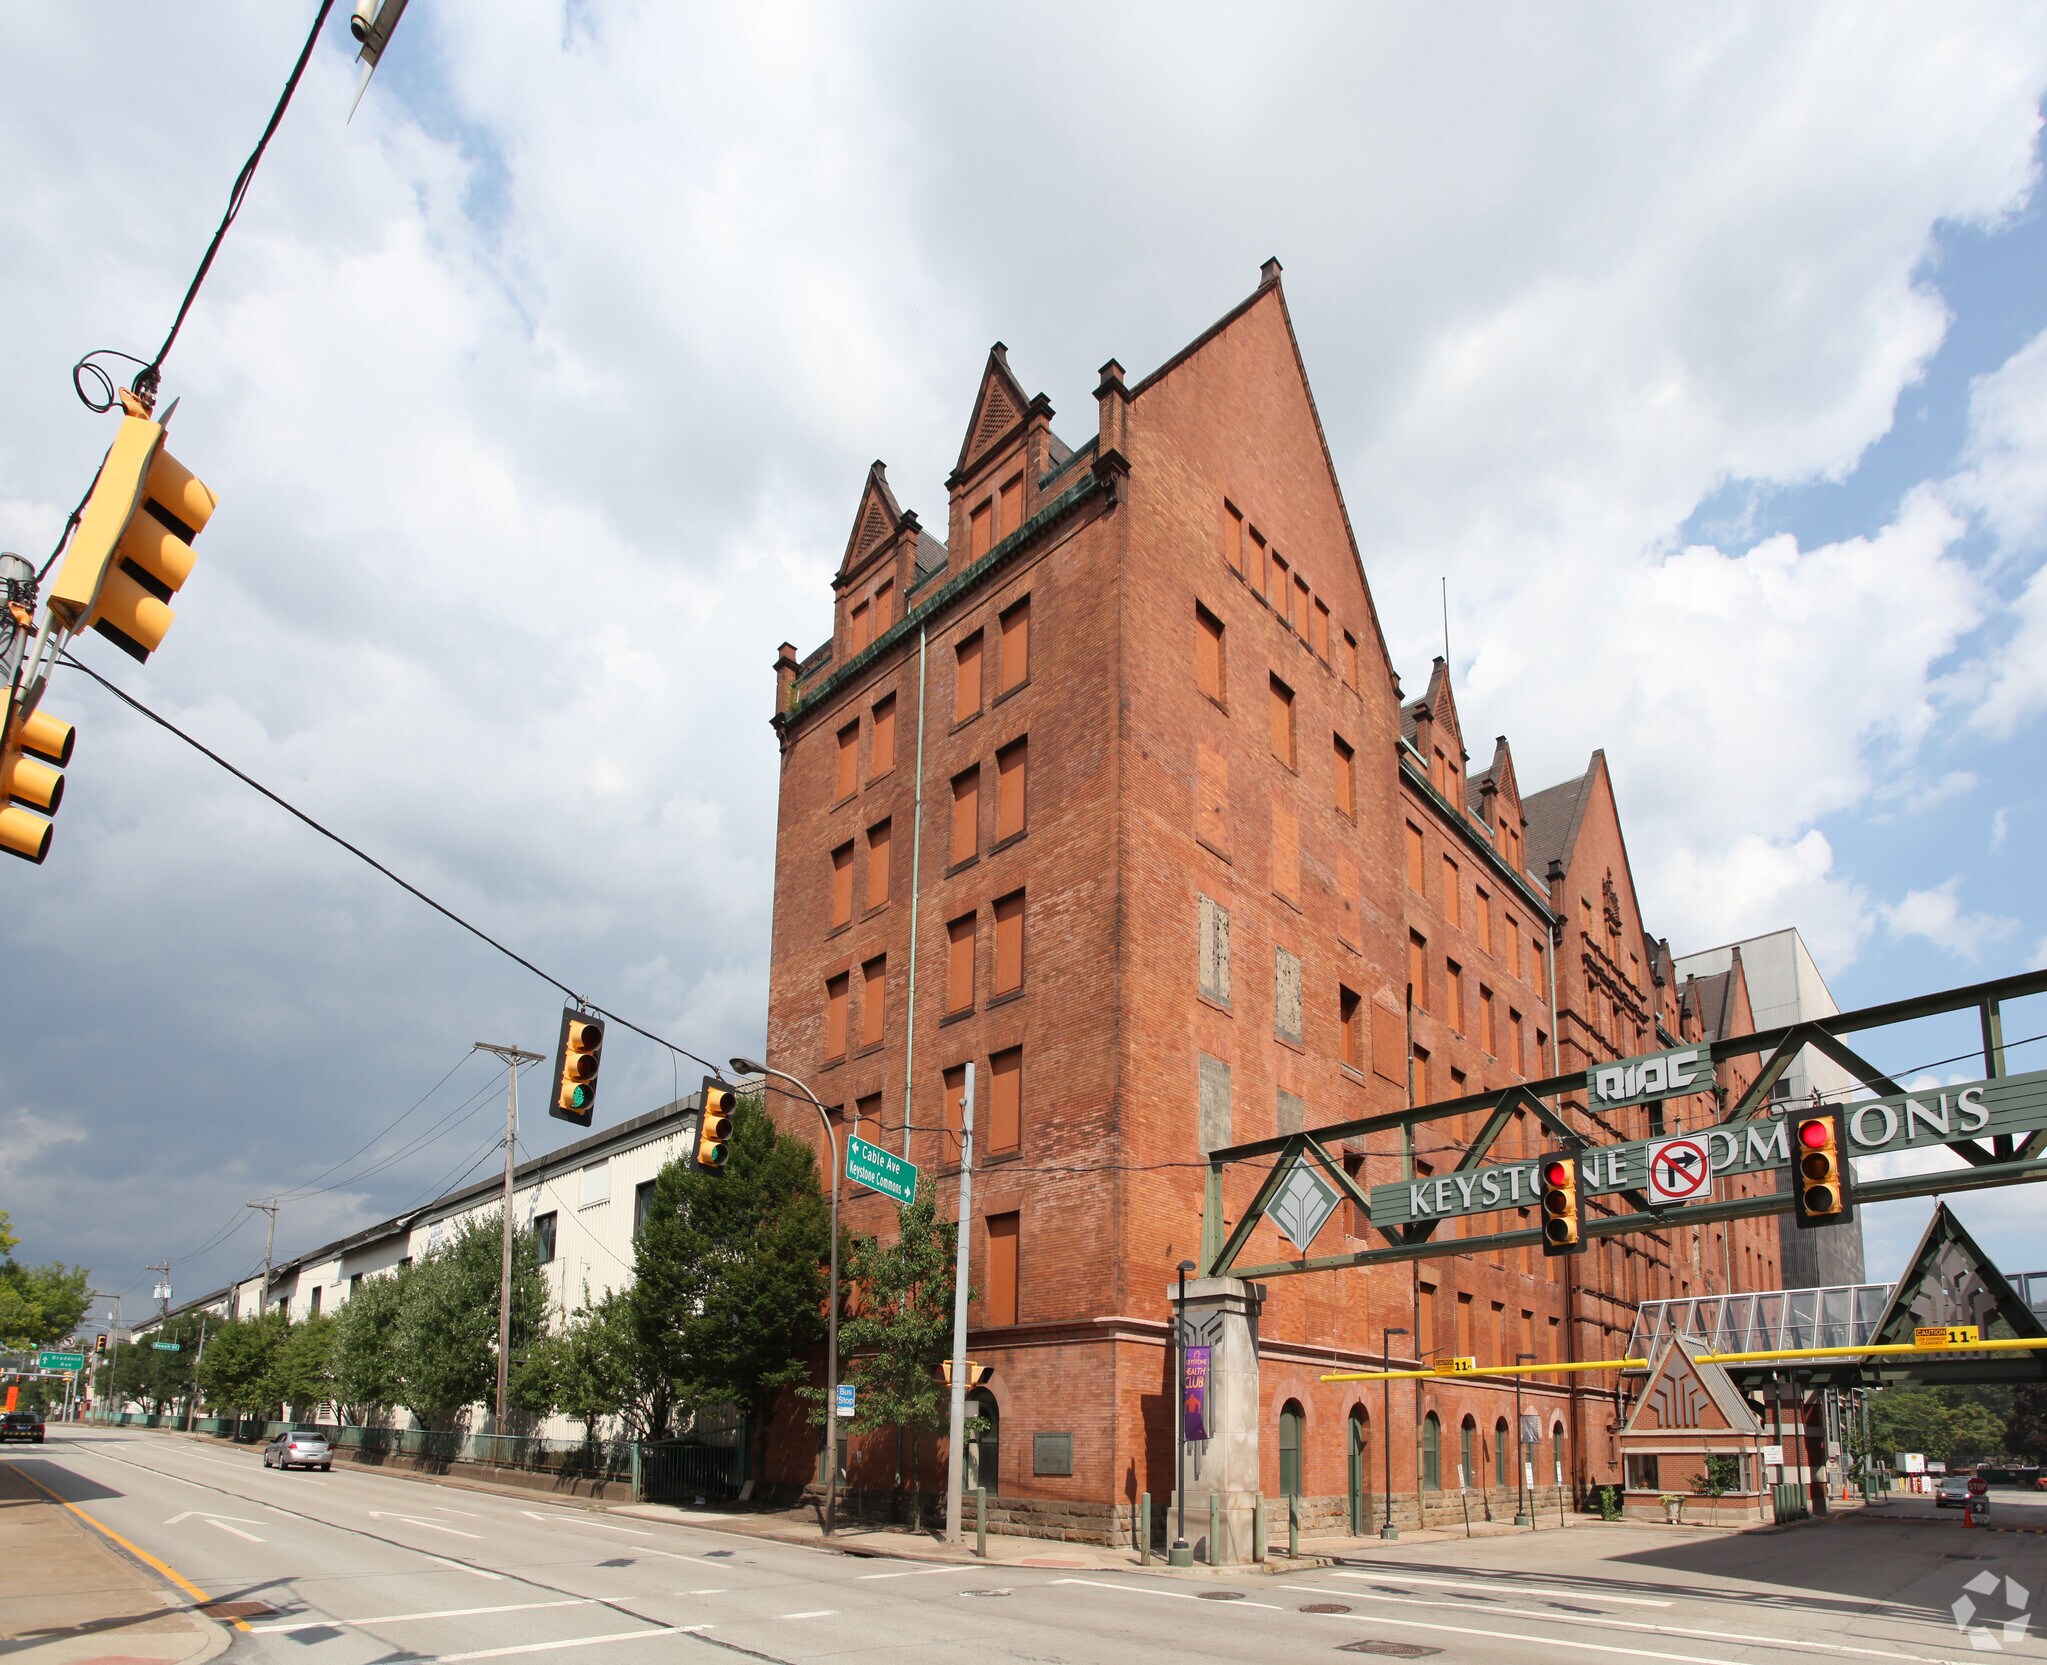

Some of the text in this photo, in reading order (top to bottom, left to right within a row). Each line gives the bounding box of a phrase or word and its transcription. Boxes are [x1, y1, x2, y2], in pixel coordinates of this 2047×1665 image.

[1710, 1087, 1990, 1171] OMONS
[862, 1146, 900, 1174] Cable Ave
[849, 1160, 902, 1195] Keystone Commons
[1948, 1331, 1970, 1343] 11
[1455, 1362, 1468, 1371] 11
[1185, 1376, 1204, 1388] CLUB
[838, 1396, 854, 1405] Stop
